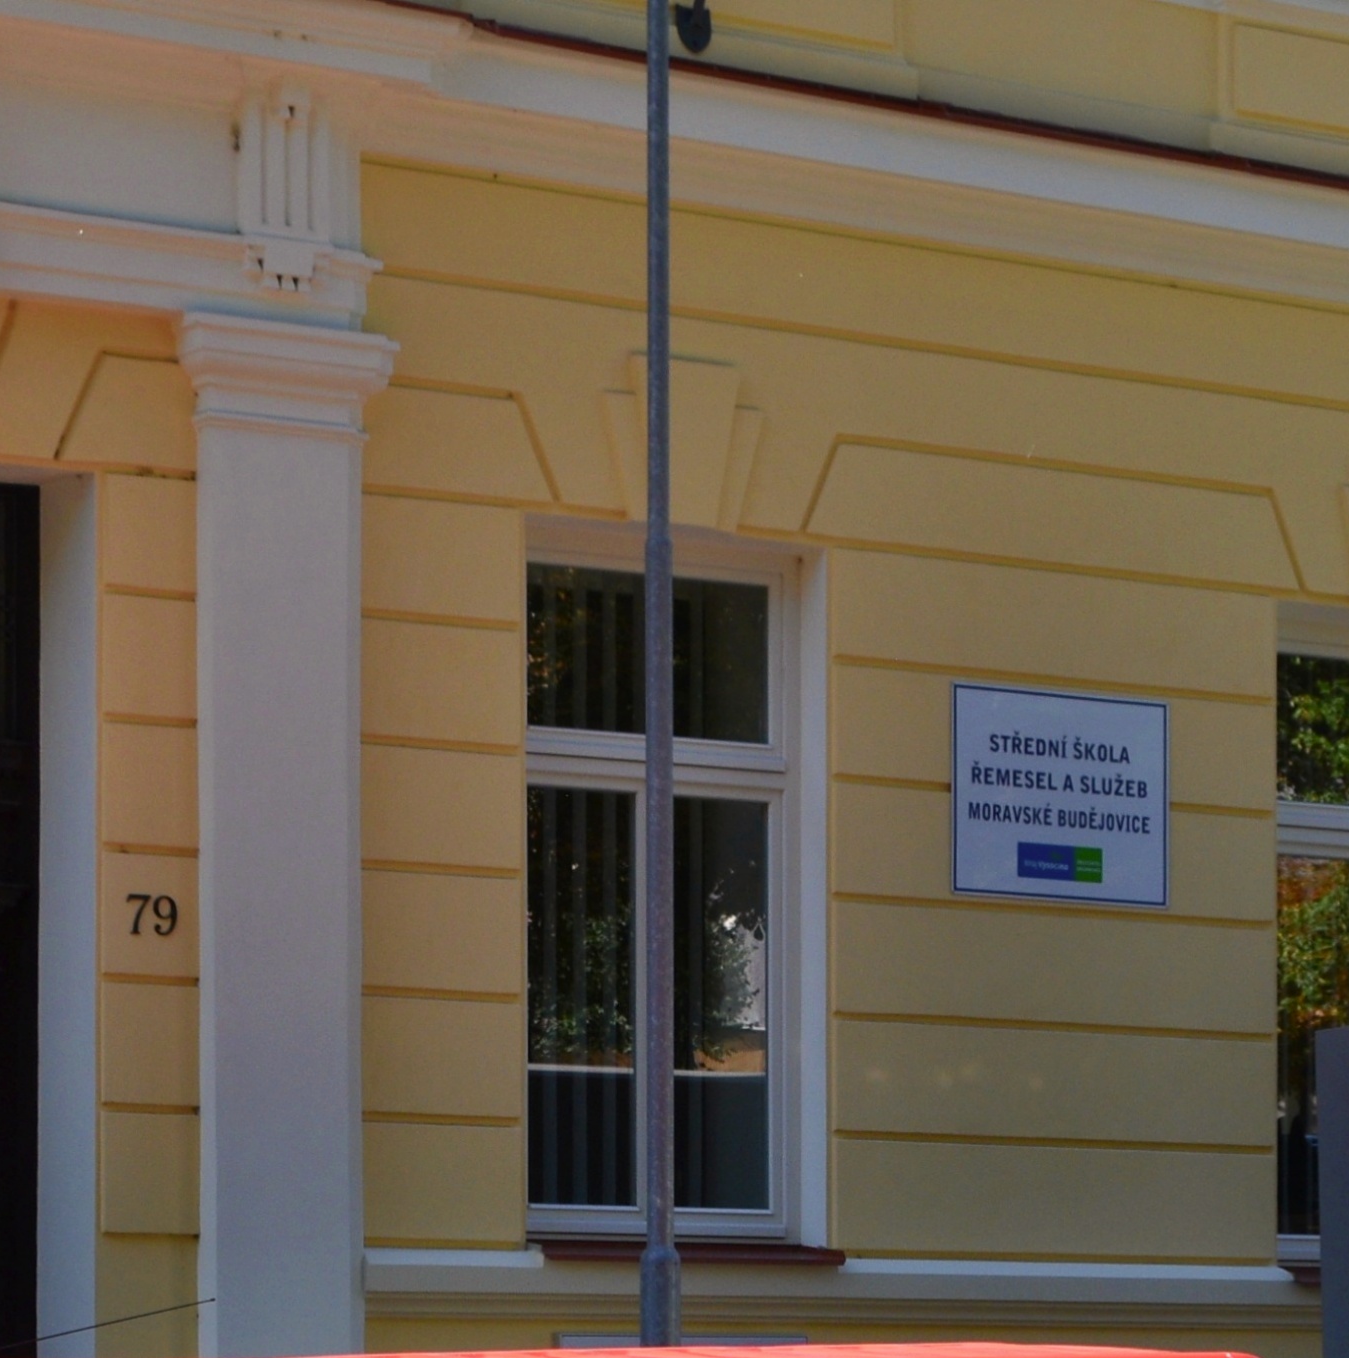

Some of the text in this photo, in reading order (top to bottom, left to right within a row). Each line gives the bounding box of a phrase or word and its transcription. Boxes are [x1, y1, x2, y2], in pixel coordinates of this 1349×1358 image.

[989, 730, 1130, 765] STŘEDNÍ ŠKOLA
[971, 761, 1148, 799] ŘEMESEL A SLUŽEB
[968, 801, 1151, 835] MORAVSKÉ BUDĚJOVICE
[126, 893, 178, 936] 79
